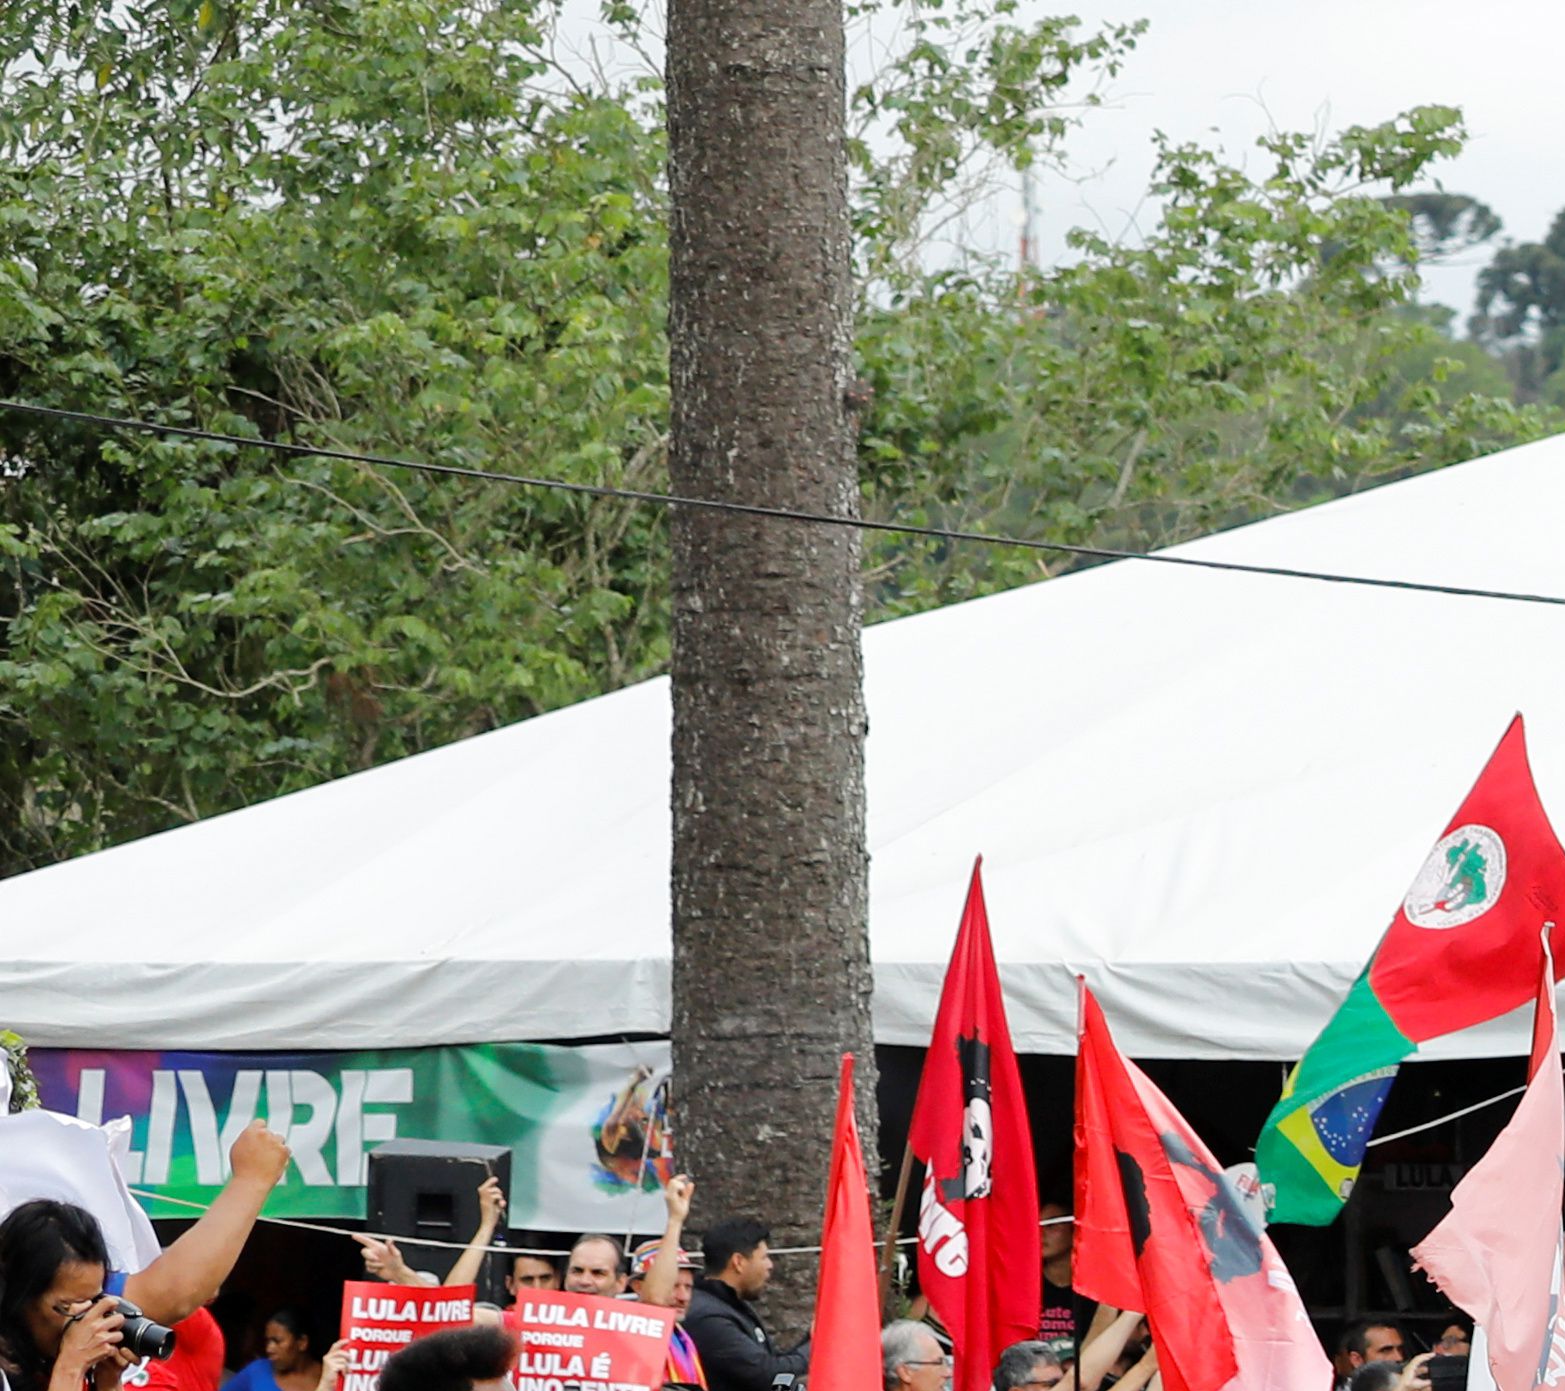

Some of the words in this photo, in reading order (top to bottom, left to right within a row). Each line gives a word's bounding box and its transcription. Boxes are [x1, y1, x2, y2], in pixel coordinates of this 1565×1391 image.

[352, 1297, 417, 1322] LULA
[422, 1299, 471, 1322] LIVRE
[523, 1302, 589, 1327] LULA
[593, 1309, 665, 1338] LIVRE
[350, 1328, 412, 1343] PORQUE
[520, 1330, 584, 1347] PORQUE
[348, 1349, 390, 1371] LU
[518, 1352, 586, 1378] LULA
[591, 1351, 611, 1379] É
